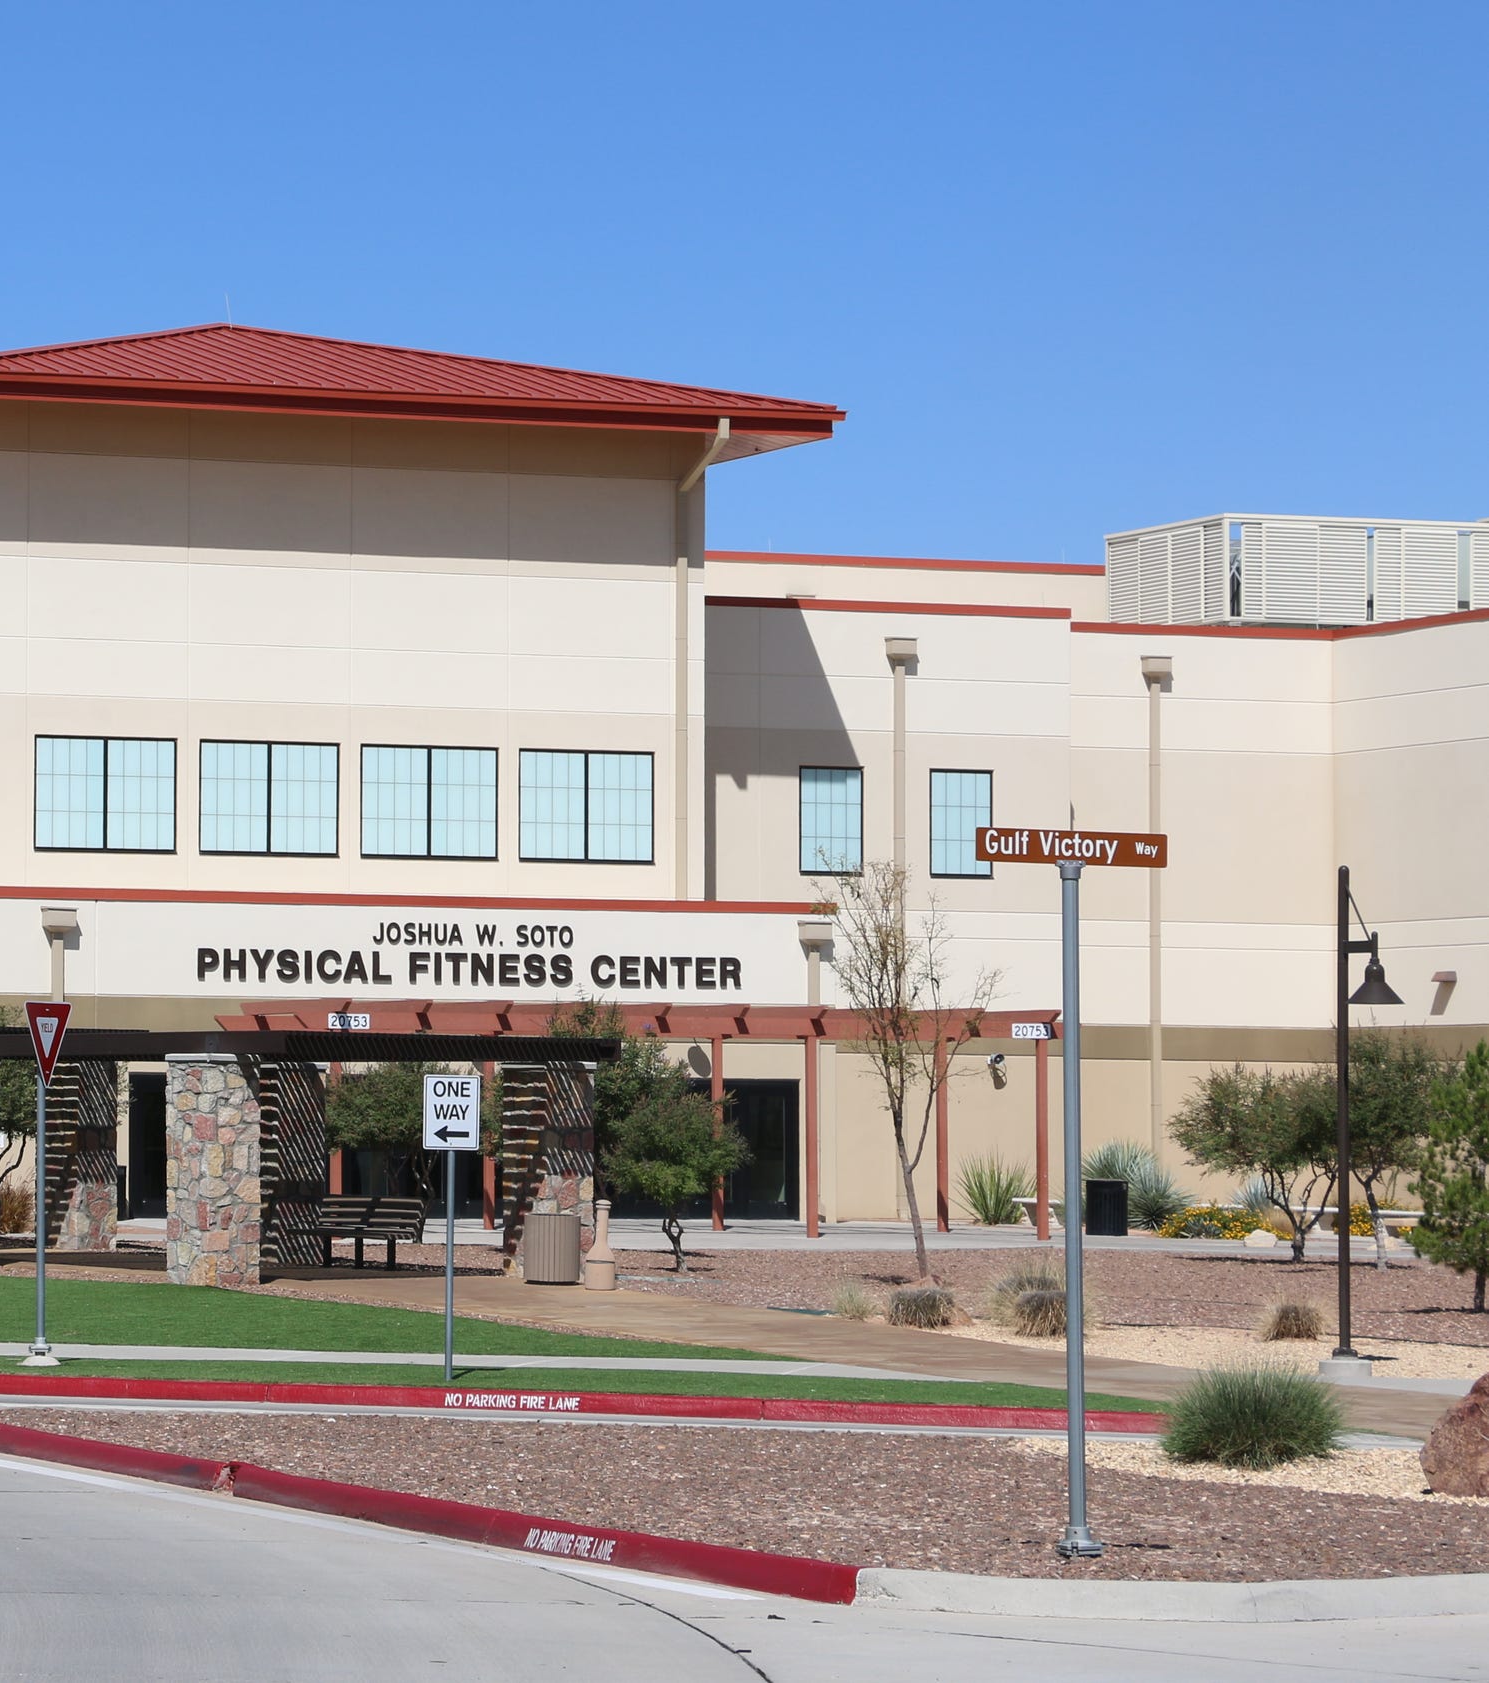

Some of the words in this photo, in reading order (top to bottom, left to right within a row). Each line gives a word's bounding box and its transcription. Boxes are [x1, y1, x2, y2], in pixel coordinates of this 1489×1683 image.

[985, 829, 1029, 855] Gulf
[1039, 831, 1118, 864] Victory
[1135, 841, 1158, 858] Way
[373, 922, 463, 946] JOSHUA
[476, 924, 504, 947] W.
[516, 924, 574, 949] SOTO
[197, 947, 392, 985] PHYSICAL
[409, 952, 573, 988] FITNESS
[590, 955, 742, 990] CENTER
[42, 1023, 53, 1033] YIELD
[331, 1015, 367, 1027] 20753
[1014, 1025, 1049, 1037] 20753
[433, 1081, 471, 1097] ONE
[434, 1104, 469, 1120] WAY
[444, 1393, 462, 1406] NO
[465, 1394, 517, 1408] PARKING
[519, 1395, 546, 1409] FIRE
[549, 1397, 580, 1411] LANE
[523, 1528, 540, 1548] NO
[536, 1530, 575, 1555] PARKING
[572, 1535, 594, 1557] FIRE
[590, 1537, 616, 1561] LANE
